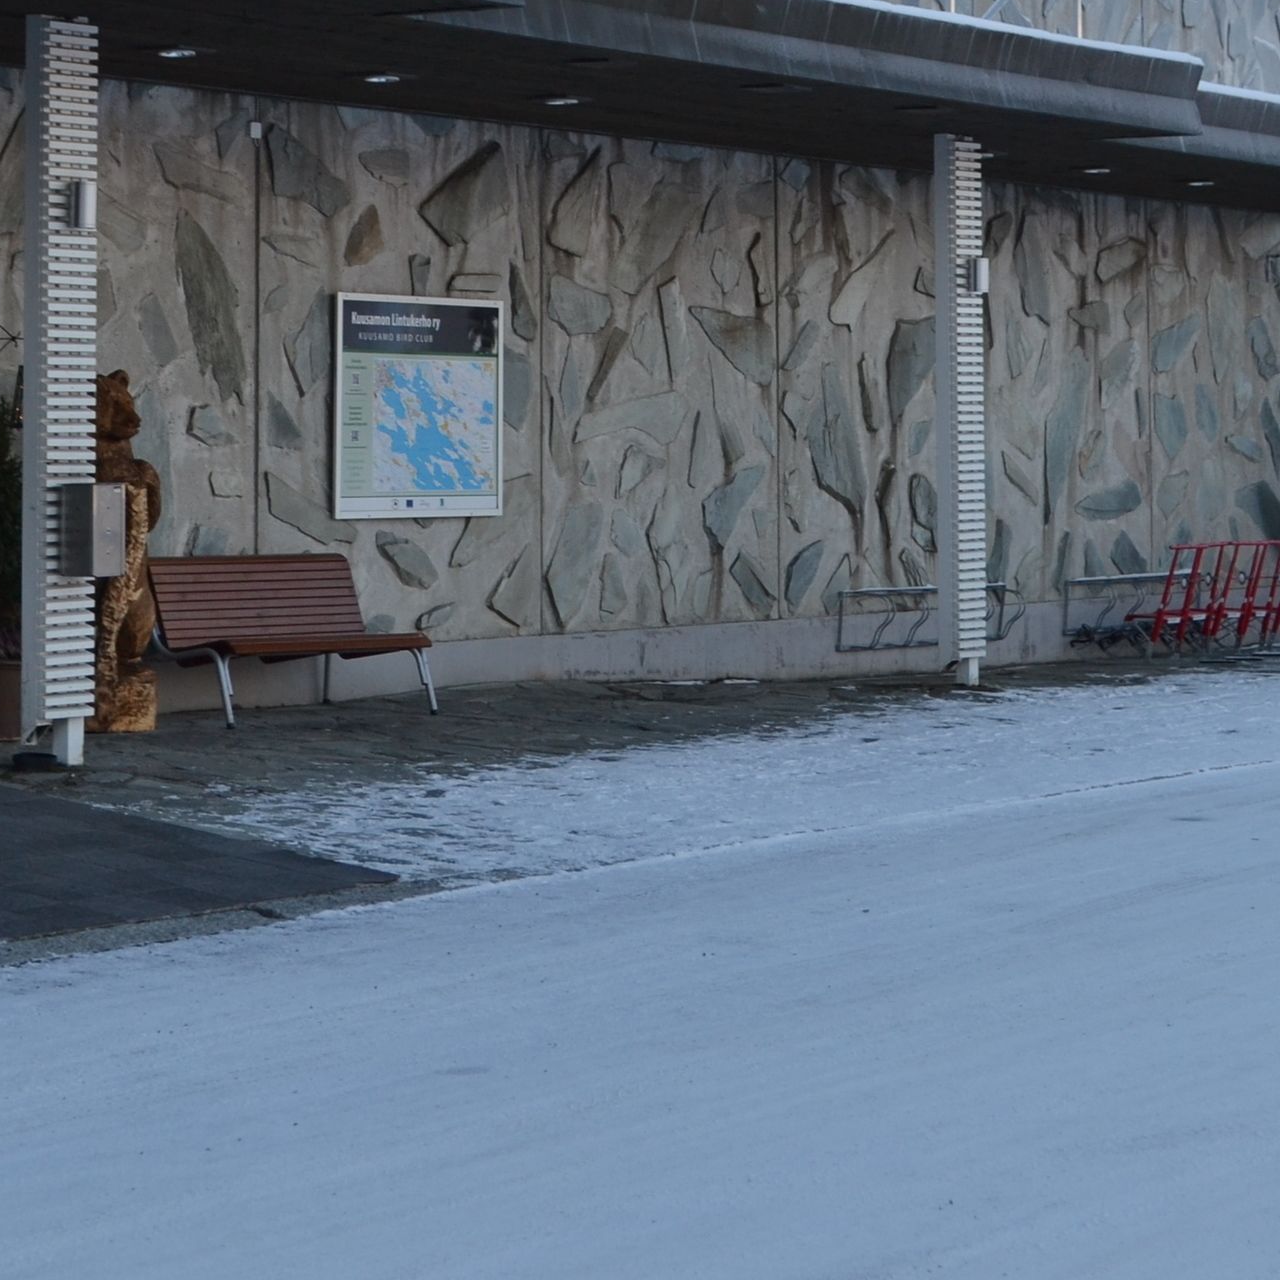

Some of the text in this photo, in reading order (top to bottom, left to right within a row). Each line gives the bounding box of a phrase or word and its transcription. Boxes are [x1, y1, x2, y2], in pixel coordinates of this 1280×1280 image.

[351, 311, 441, 331] Kuusamon Lintukerho ry
[358, 331, 434, 344] KUUSAMO BIRD CLUB
